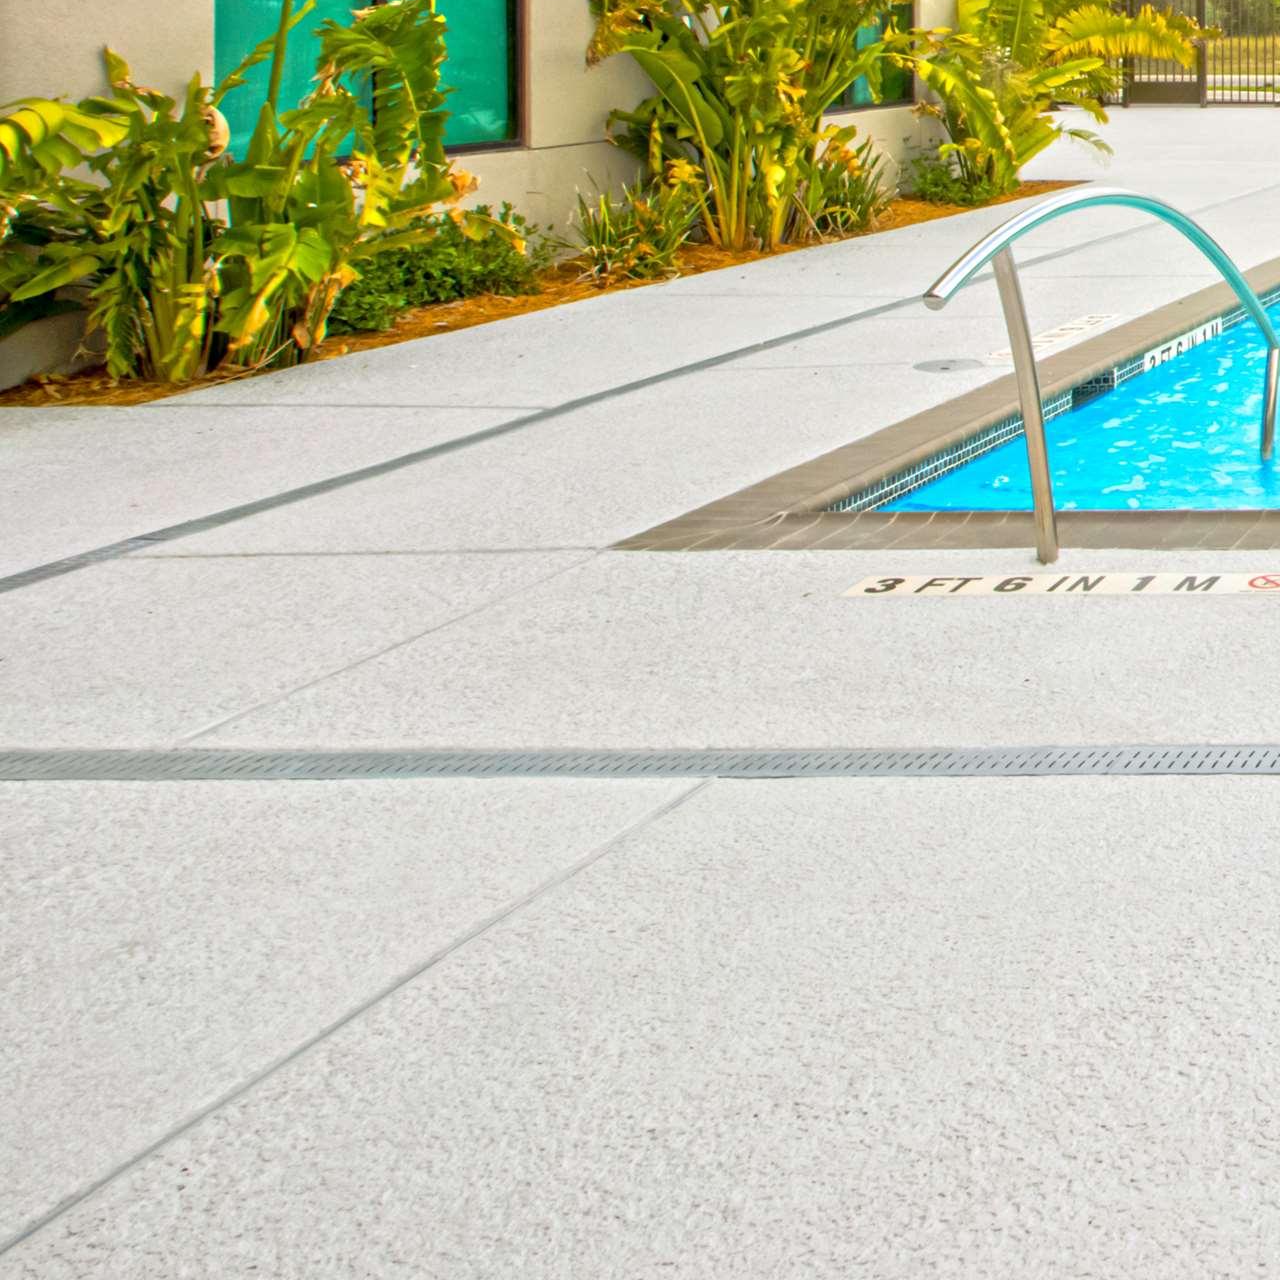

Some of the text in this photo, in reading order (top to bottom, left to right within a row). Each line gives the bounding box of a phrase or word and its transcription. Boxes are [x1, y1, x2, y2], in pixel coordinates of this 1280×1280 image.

[864, 576, 1221, 593] 3 FT 6 IN 1 M
